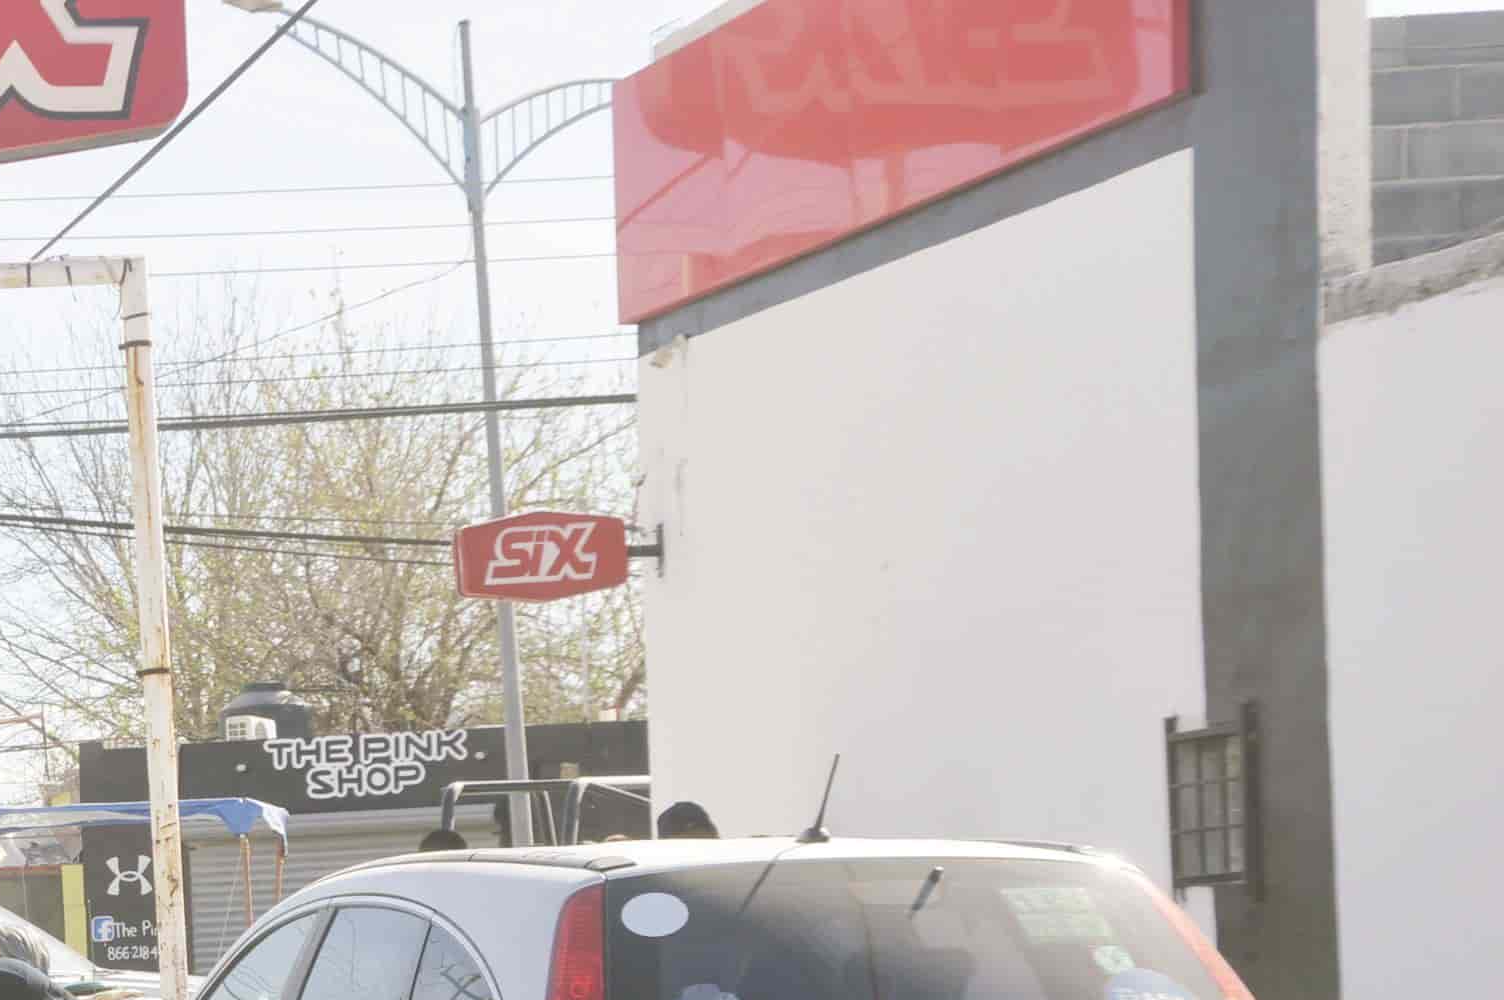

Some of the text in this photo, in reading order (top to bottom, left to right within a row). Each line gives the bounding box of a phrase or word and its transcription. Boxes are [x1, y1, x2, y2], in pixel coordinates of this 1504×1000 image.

[483, 521, 598, 586] SIX
[263, 729, 469, 770] THE PINK
[307, 761, 426, 799] SHOP
